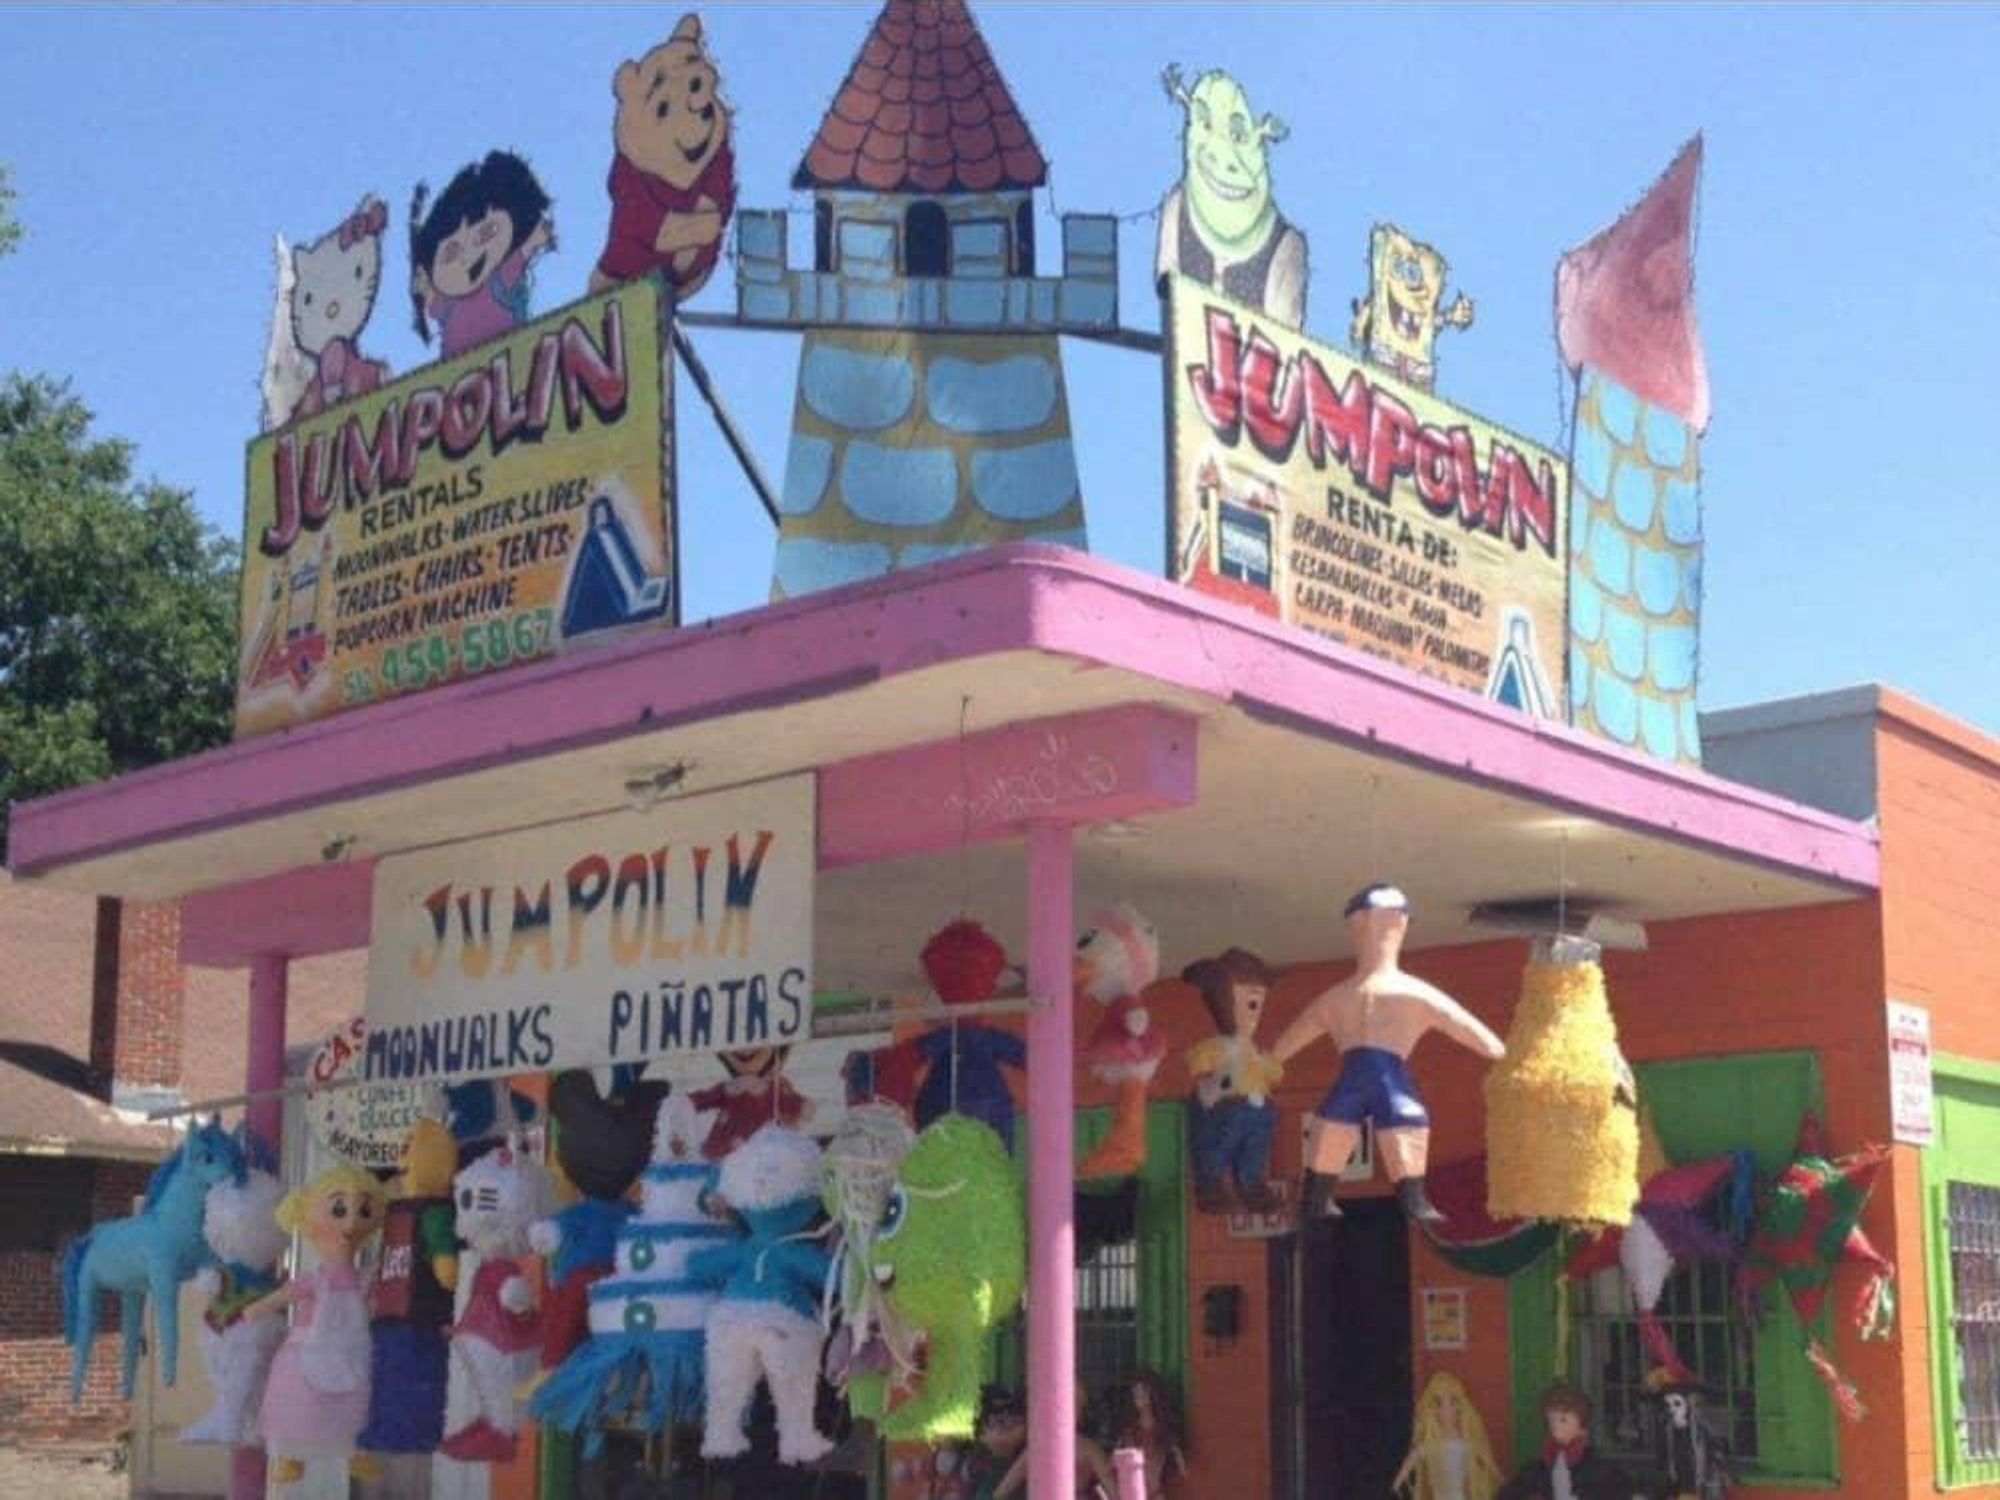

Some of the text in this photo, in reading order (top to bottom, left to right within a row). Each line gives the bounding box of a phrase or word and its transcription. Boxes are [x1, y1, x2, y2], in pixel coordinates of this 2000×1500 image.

[259, 300, 627, 557] JUMPOLIN
[1187, 305, 1556, 558] JUMPOLIN
[360, 466, 483, 538] RENTALS
[1327, 486, 1458, 568] RENTA DE:
[413, 546, 484, 595] CHAIRS
[496, 522, 571, 570] TENTS
[334, 576, 517, 655] POPCORN MACHINE
[409, 829, 774, 981] JUMPOLIN
[365, 967, 805, 1081] MOONWALKS PIÑATAS
